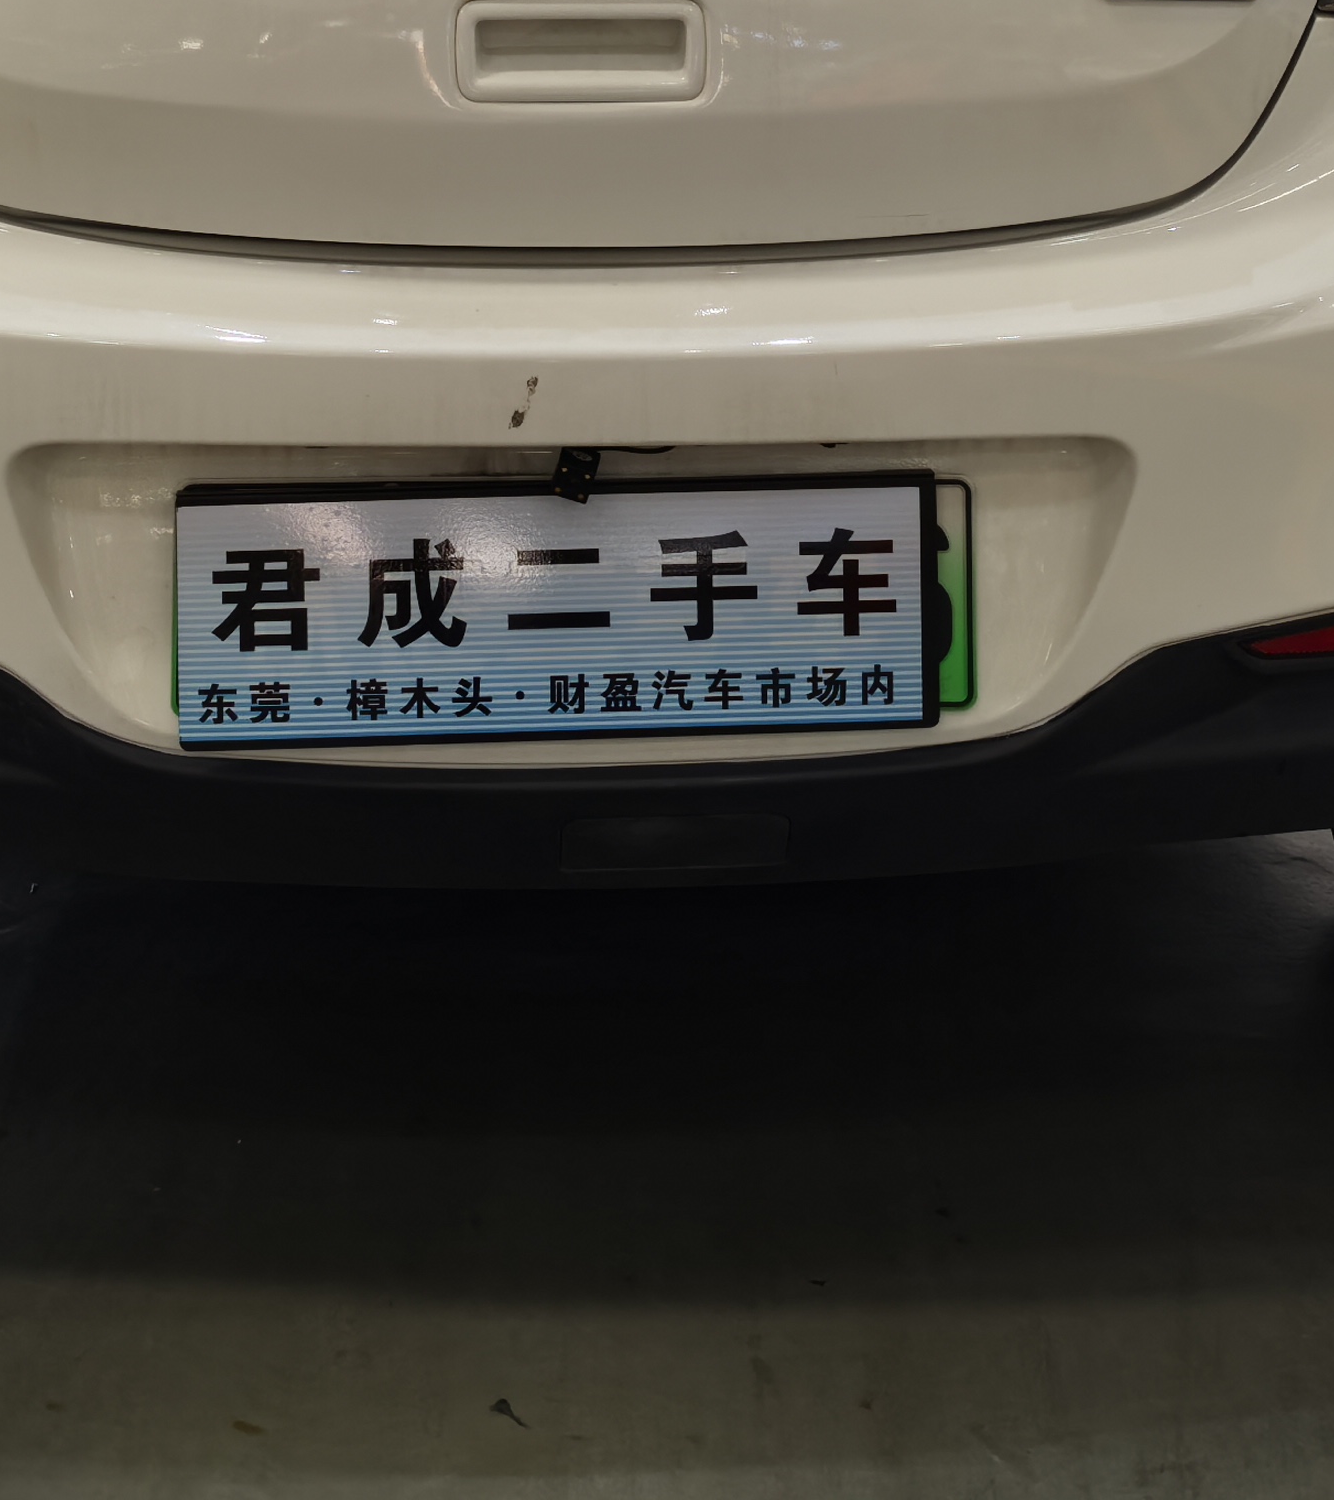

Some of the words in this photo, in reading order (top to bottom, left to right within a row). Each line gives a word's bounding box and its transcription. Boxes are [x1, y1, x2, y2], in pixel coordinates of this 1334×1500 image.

[211, 527, 897, 652] 君成二手车
